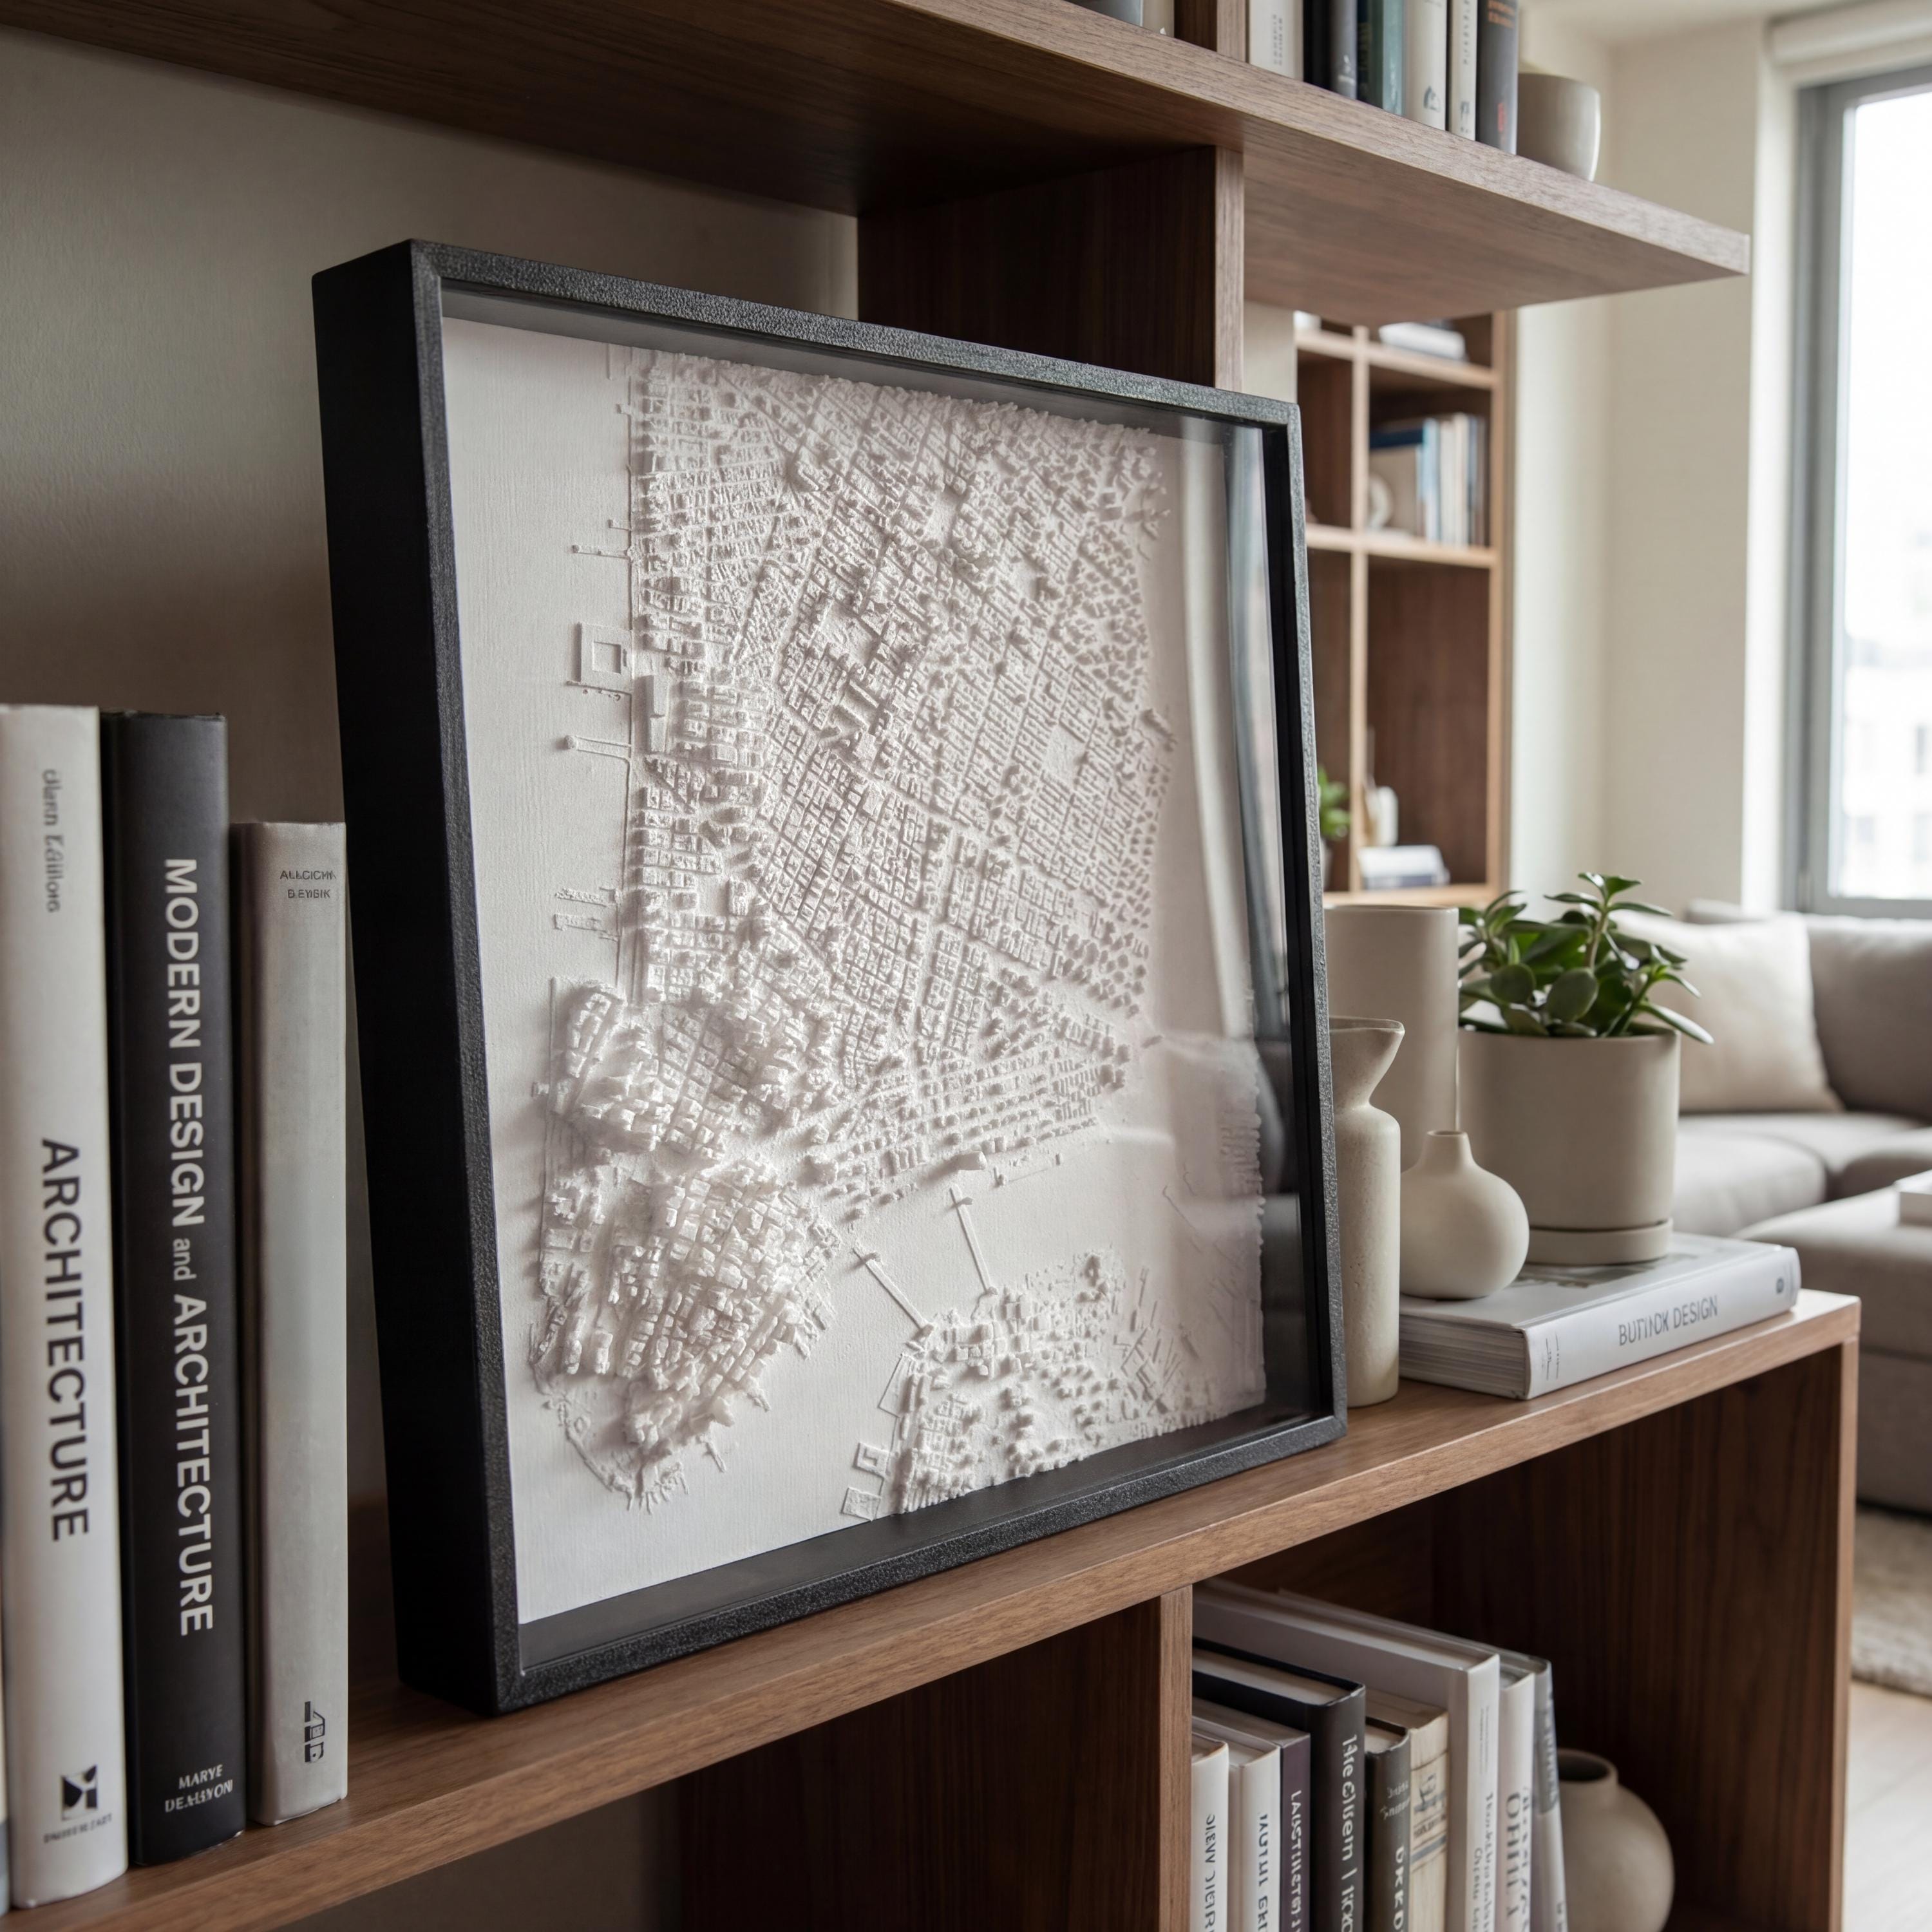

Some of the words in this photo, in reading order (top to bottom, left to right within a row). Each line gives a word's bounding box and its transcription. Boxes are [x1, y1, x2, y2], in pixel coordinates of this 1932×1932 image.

[164, 858, 201, 1048] MODERN
[169, 1063, 205, 1227] DESIGN
[41, 1137, 89, 1541] ARCHITECTURE
[173, 1238, 196, 1281] and
[1673, 1295, 1718, 1329] DESIGN
[174, 1294, 213, 1636] ARCHITECTURE
[178, 1764, 223, 1789] MARYE
